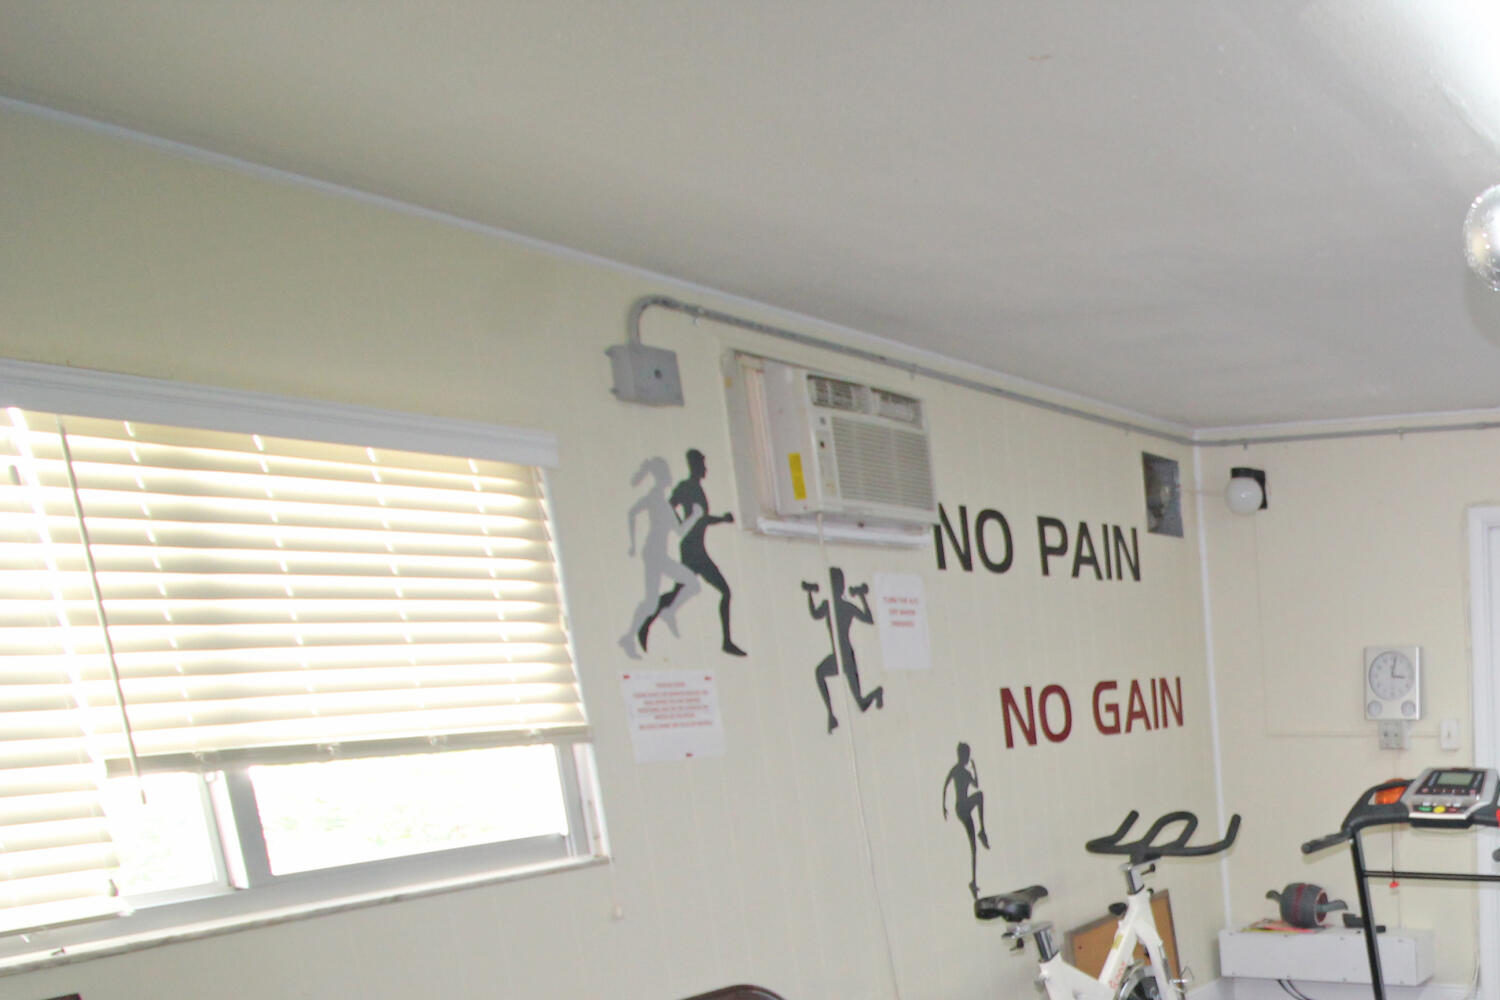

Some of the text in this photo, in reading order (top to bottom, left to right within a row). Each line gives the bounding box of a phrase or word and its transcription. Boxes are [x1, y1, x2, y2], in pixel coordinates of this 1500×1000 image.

[933, 502, 1141, 582] NO PAIN
[1000, 676, 1183, 749] NO GAIN
